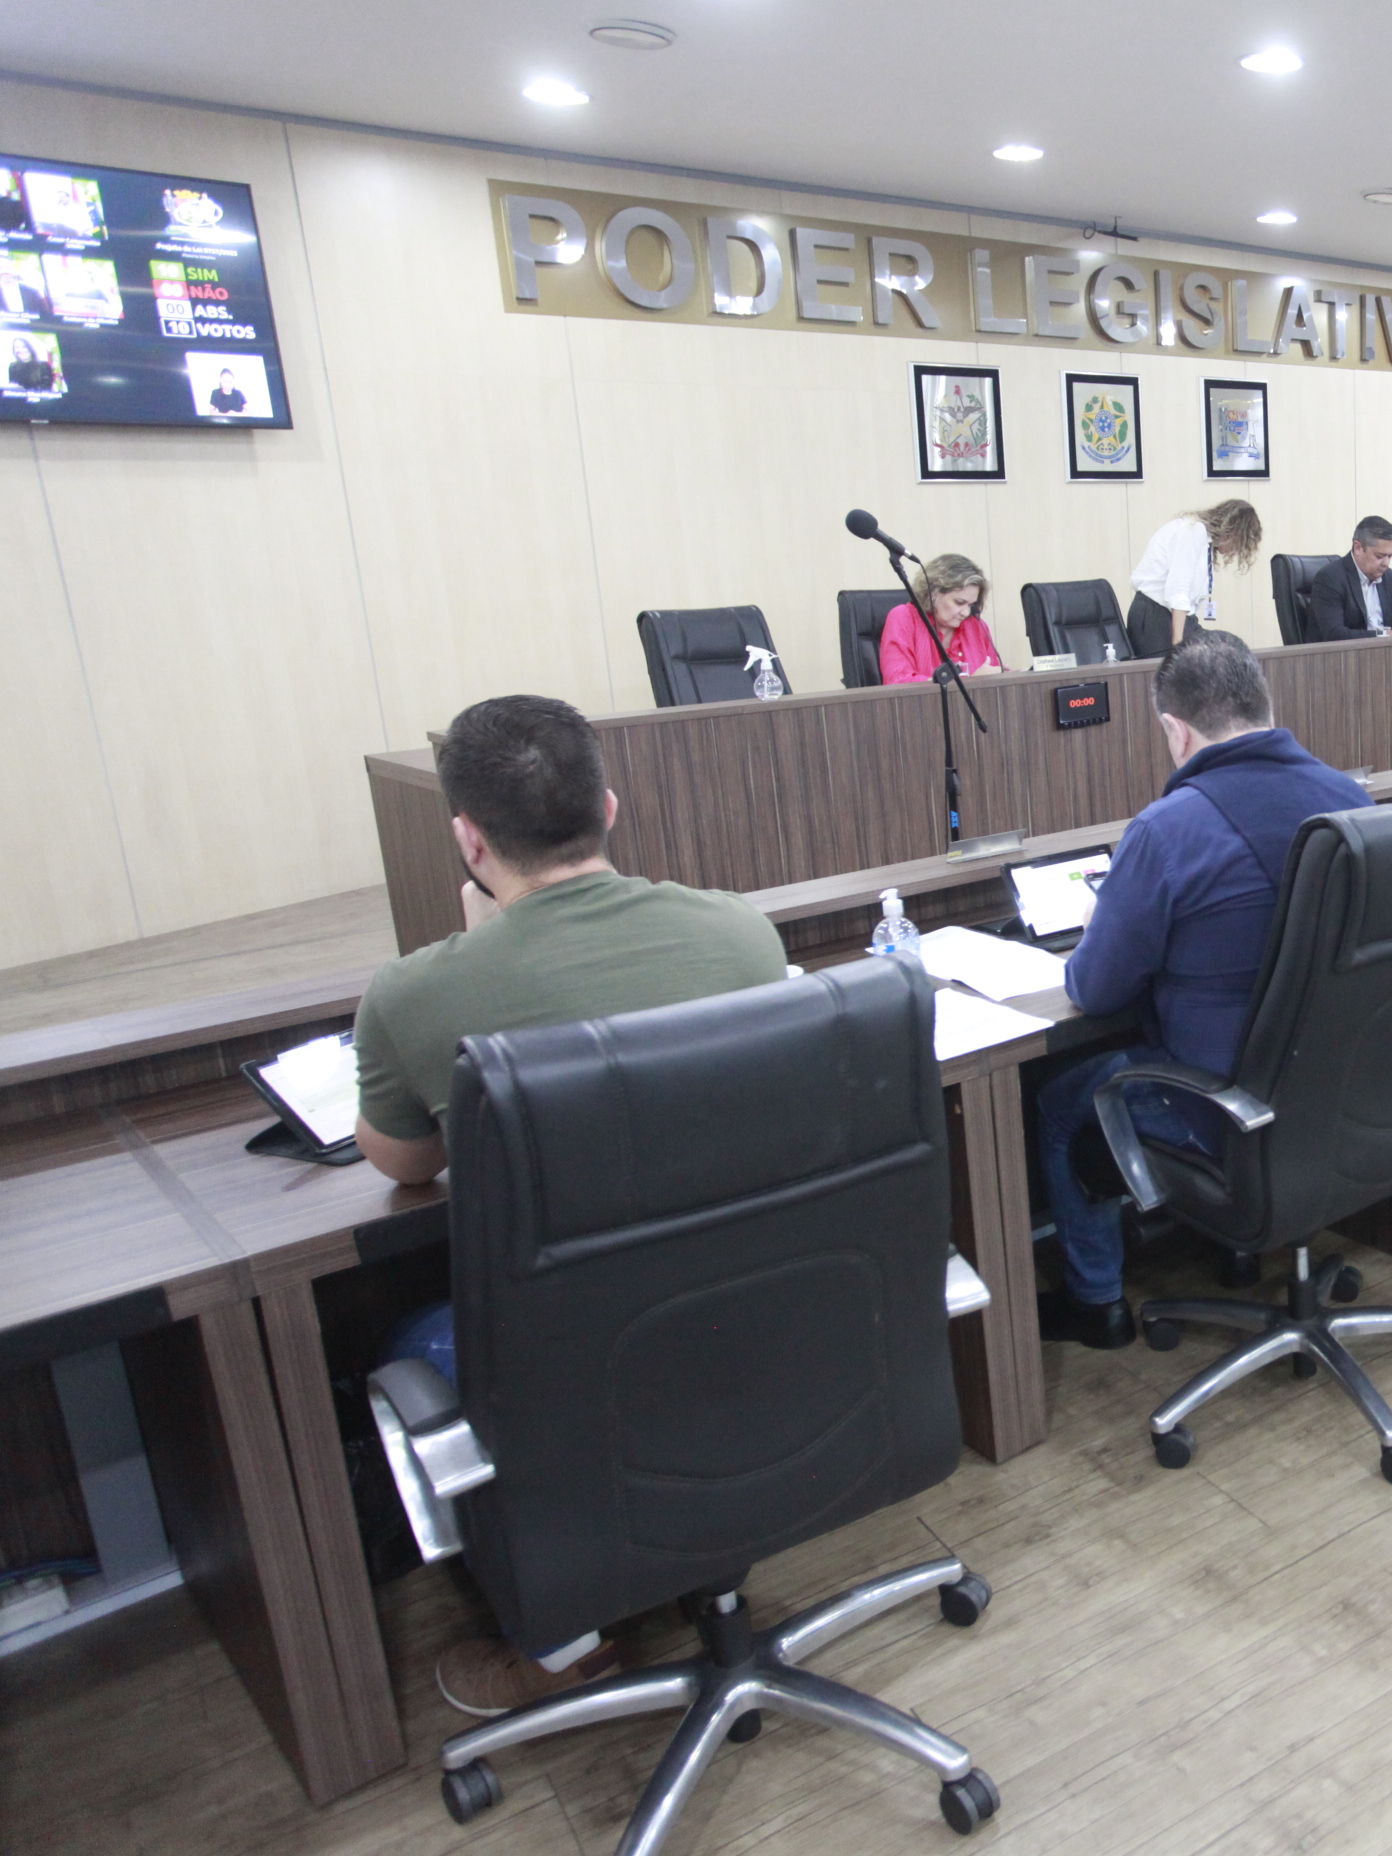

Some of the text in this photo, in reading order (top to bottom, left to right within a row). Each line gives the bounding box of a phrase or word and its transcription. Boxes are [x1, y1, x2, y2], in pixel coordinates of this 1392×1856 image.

[503, 193, 941, 330] PODER
[157, 263, 219, 282] 10 SIM
[161, 282, 229, 300] 00 NÃO
[166, 302, 234, 320] 00 ABS.
[168, 321, 257, 340] 10 VOTOS
[1069, 697, 1095, 708] 00:00
